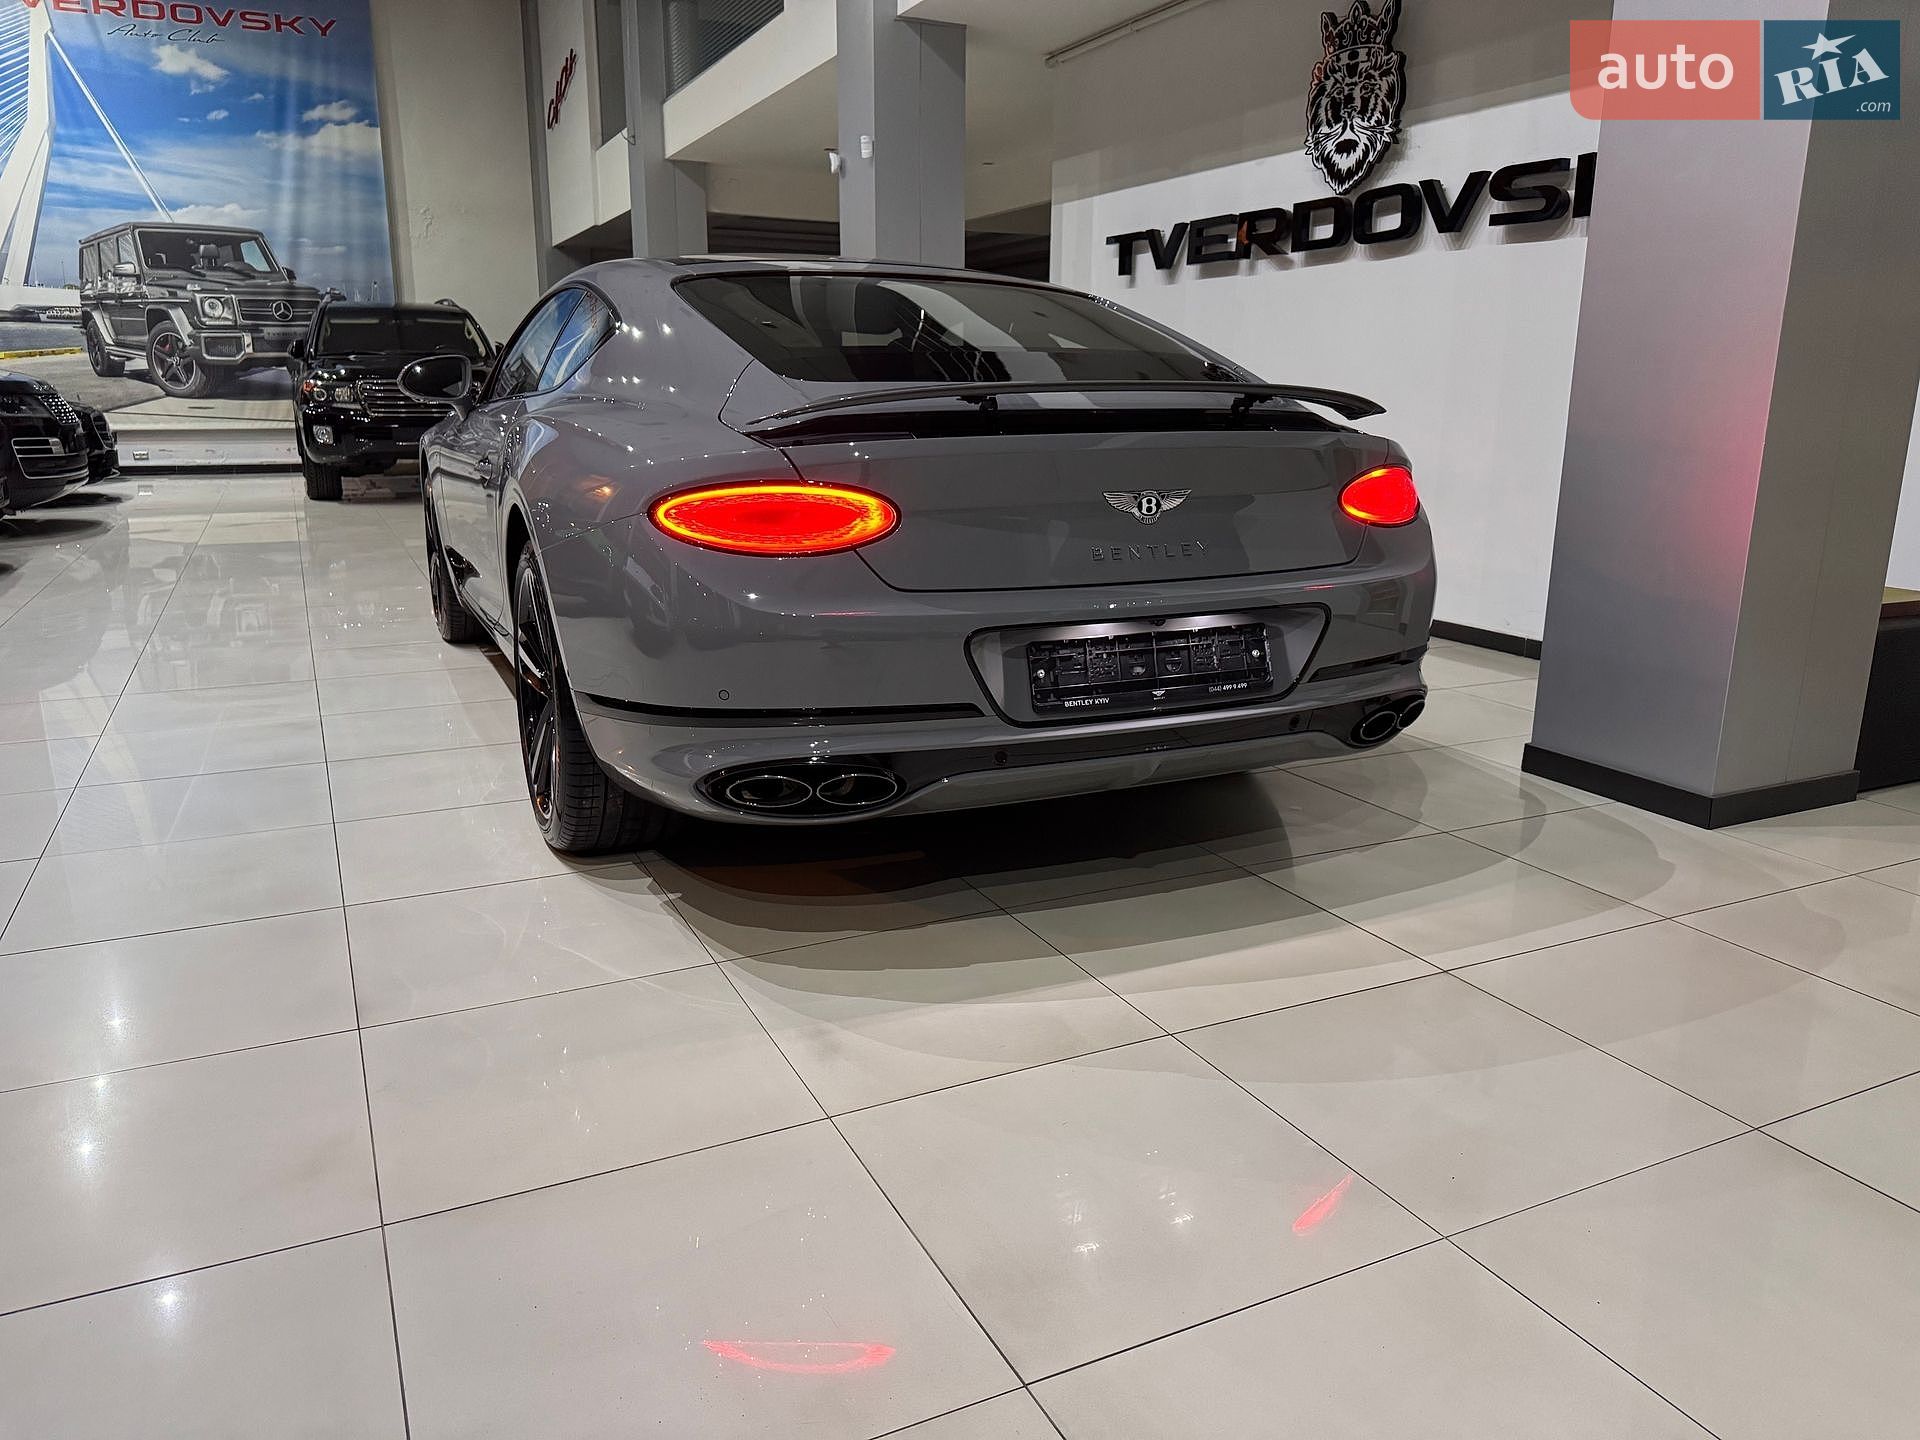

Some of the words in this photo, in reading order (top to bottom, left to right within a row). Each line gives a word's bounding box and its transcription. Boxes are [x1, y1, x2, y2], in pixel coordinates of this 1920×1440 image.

[107, 23, 162, 38] Auto
[167, 28, 225, 44] Club
[1091, 539, 1208, 561] BENTLEY
[1064, 698, 1093, 708] BENTLEY
